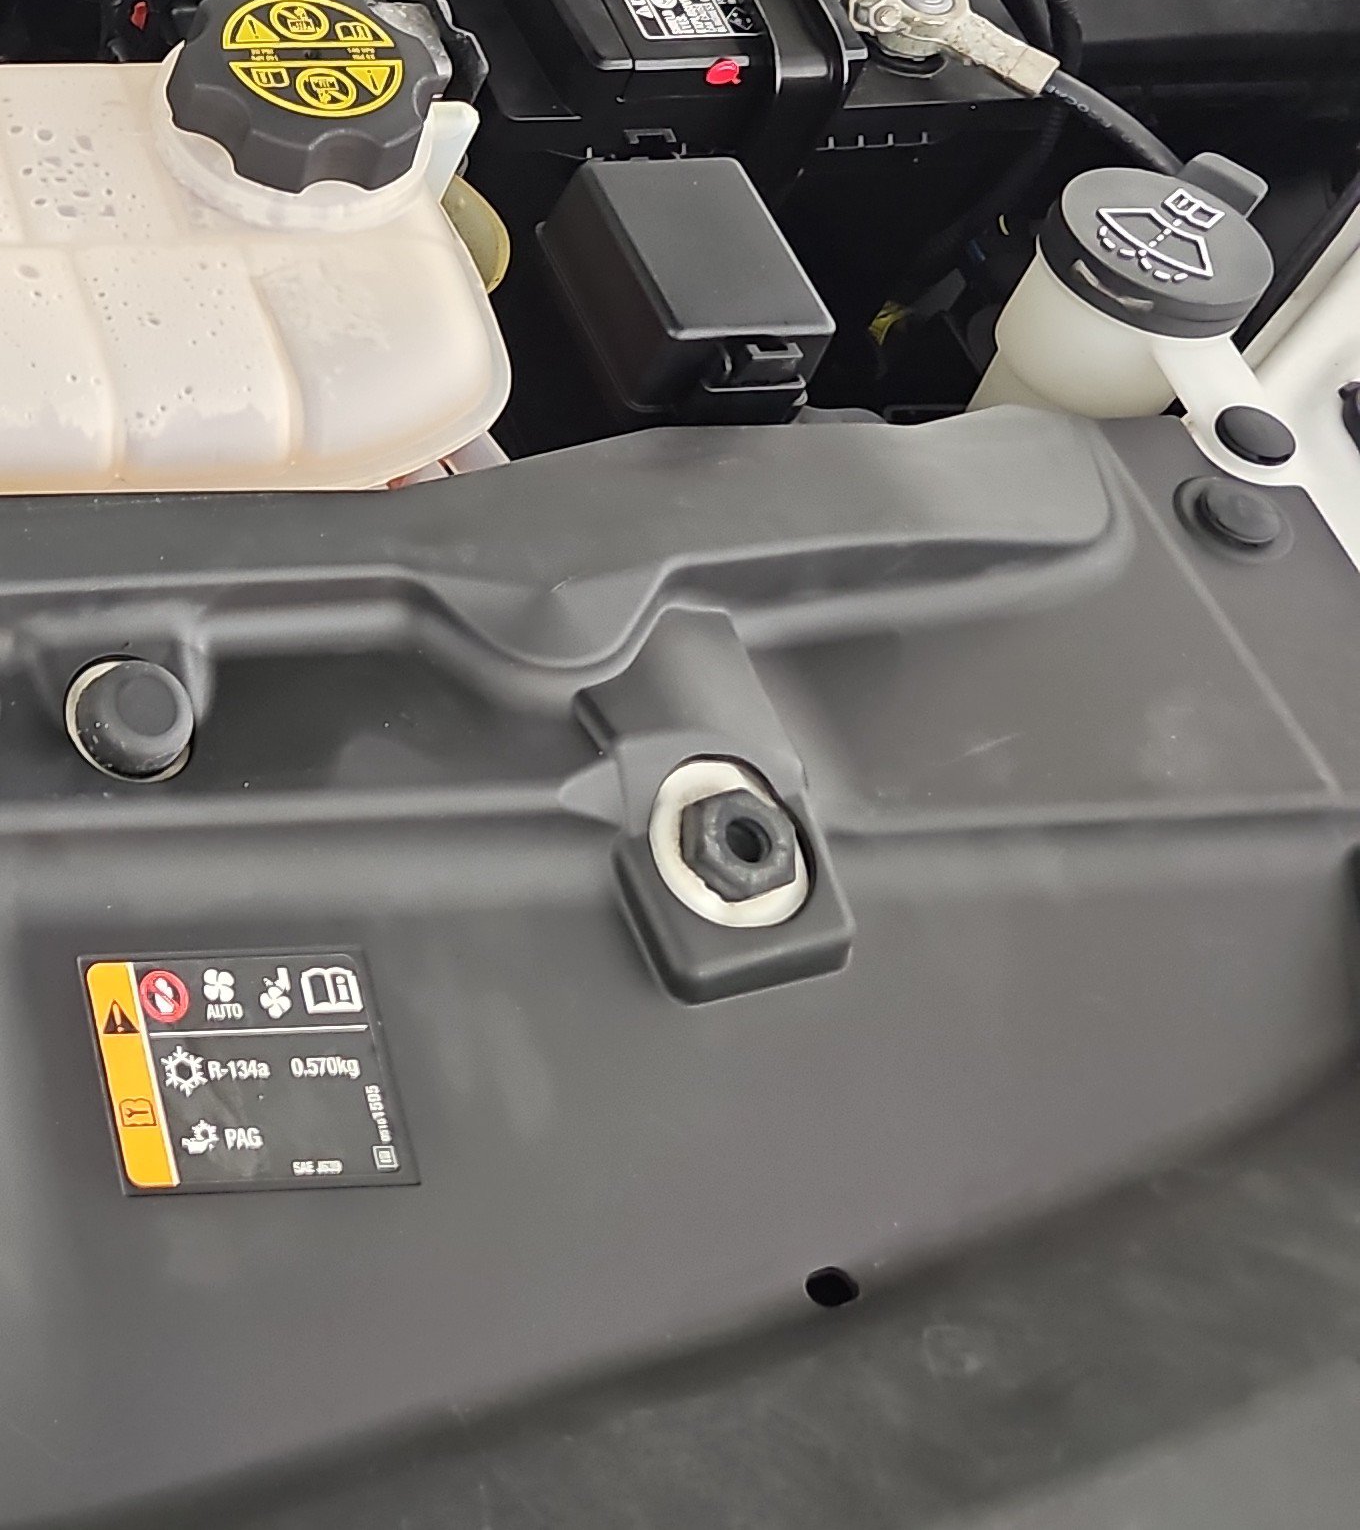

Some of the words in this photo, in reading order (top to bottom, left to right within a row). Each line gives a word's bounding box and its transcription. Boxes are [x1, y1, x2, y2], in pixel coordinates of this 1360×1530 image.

[206, 1003, 244, 1021] AUTO
[208, 1058, 271, 1081] R-134a
[290, 1055, 361, 1080] 0.570kg
[224, 1127, 264, 1151] PAG
